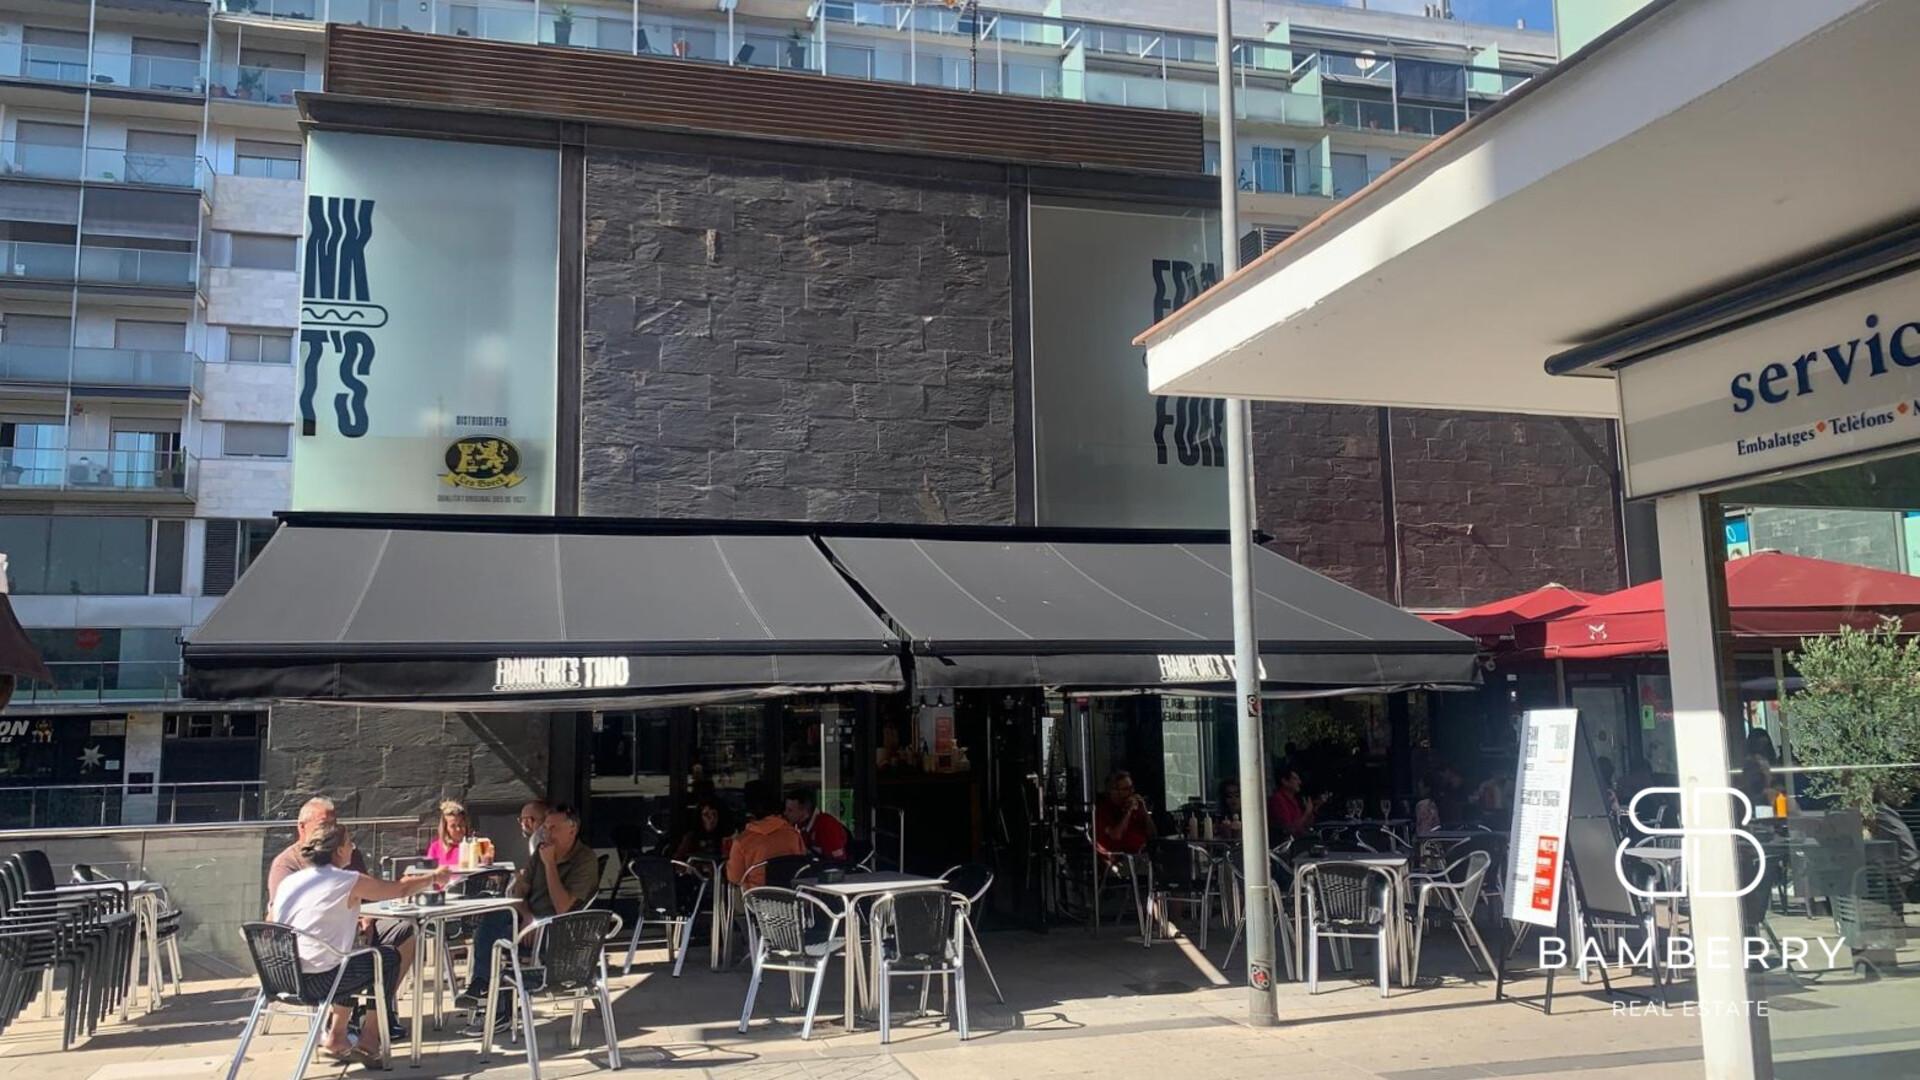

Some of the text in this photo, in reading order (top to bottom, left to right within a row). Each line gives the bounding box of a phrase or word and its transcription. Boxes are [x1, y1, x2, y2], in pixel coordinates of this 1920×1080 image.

[1737, 411, 1895, 456] Embalatges Telèfons
[496, 656, 630, 688] FRANKFURT'S TINO
